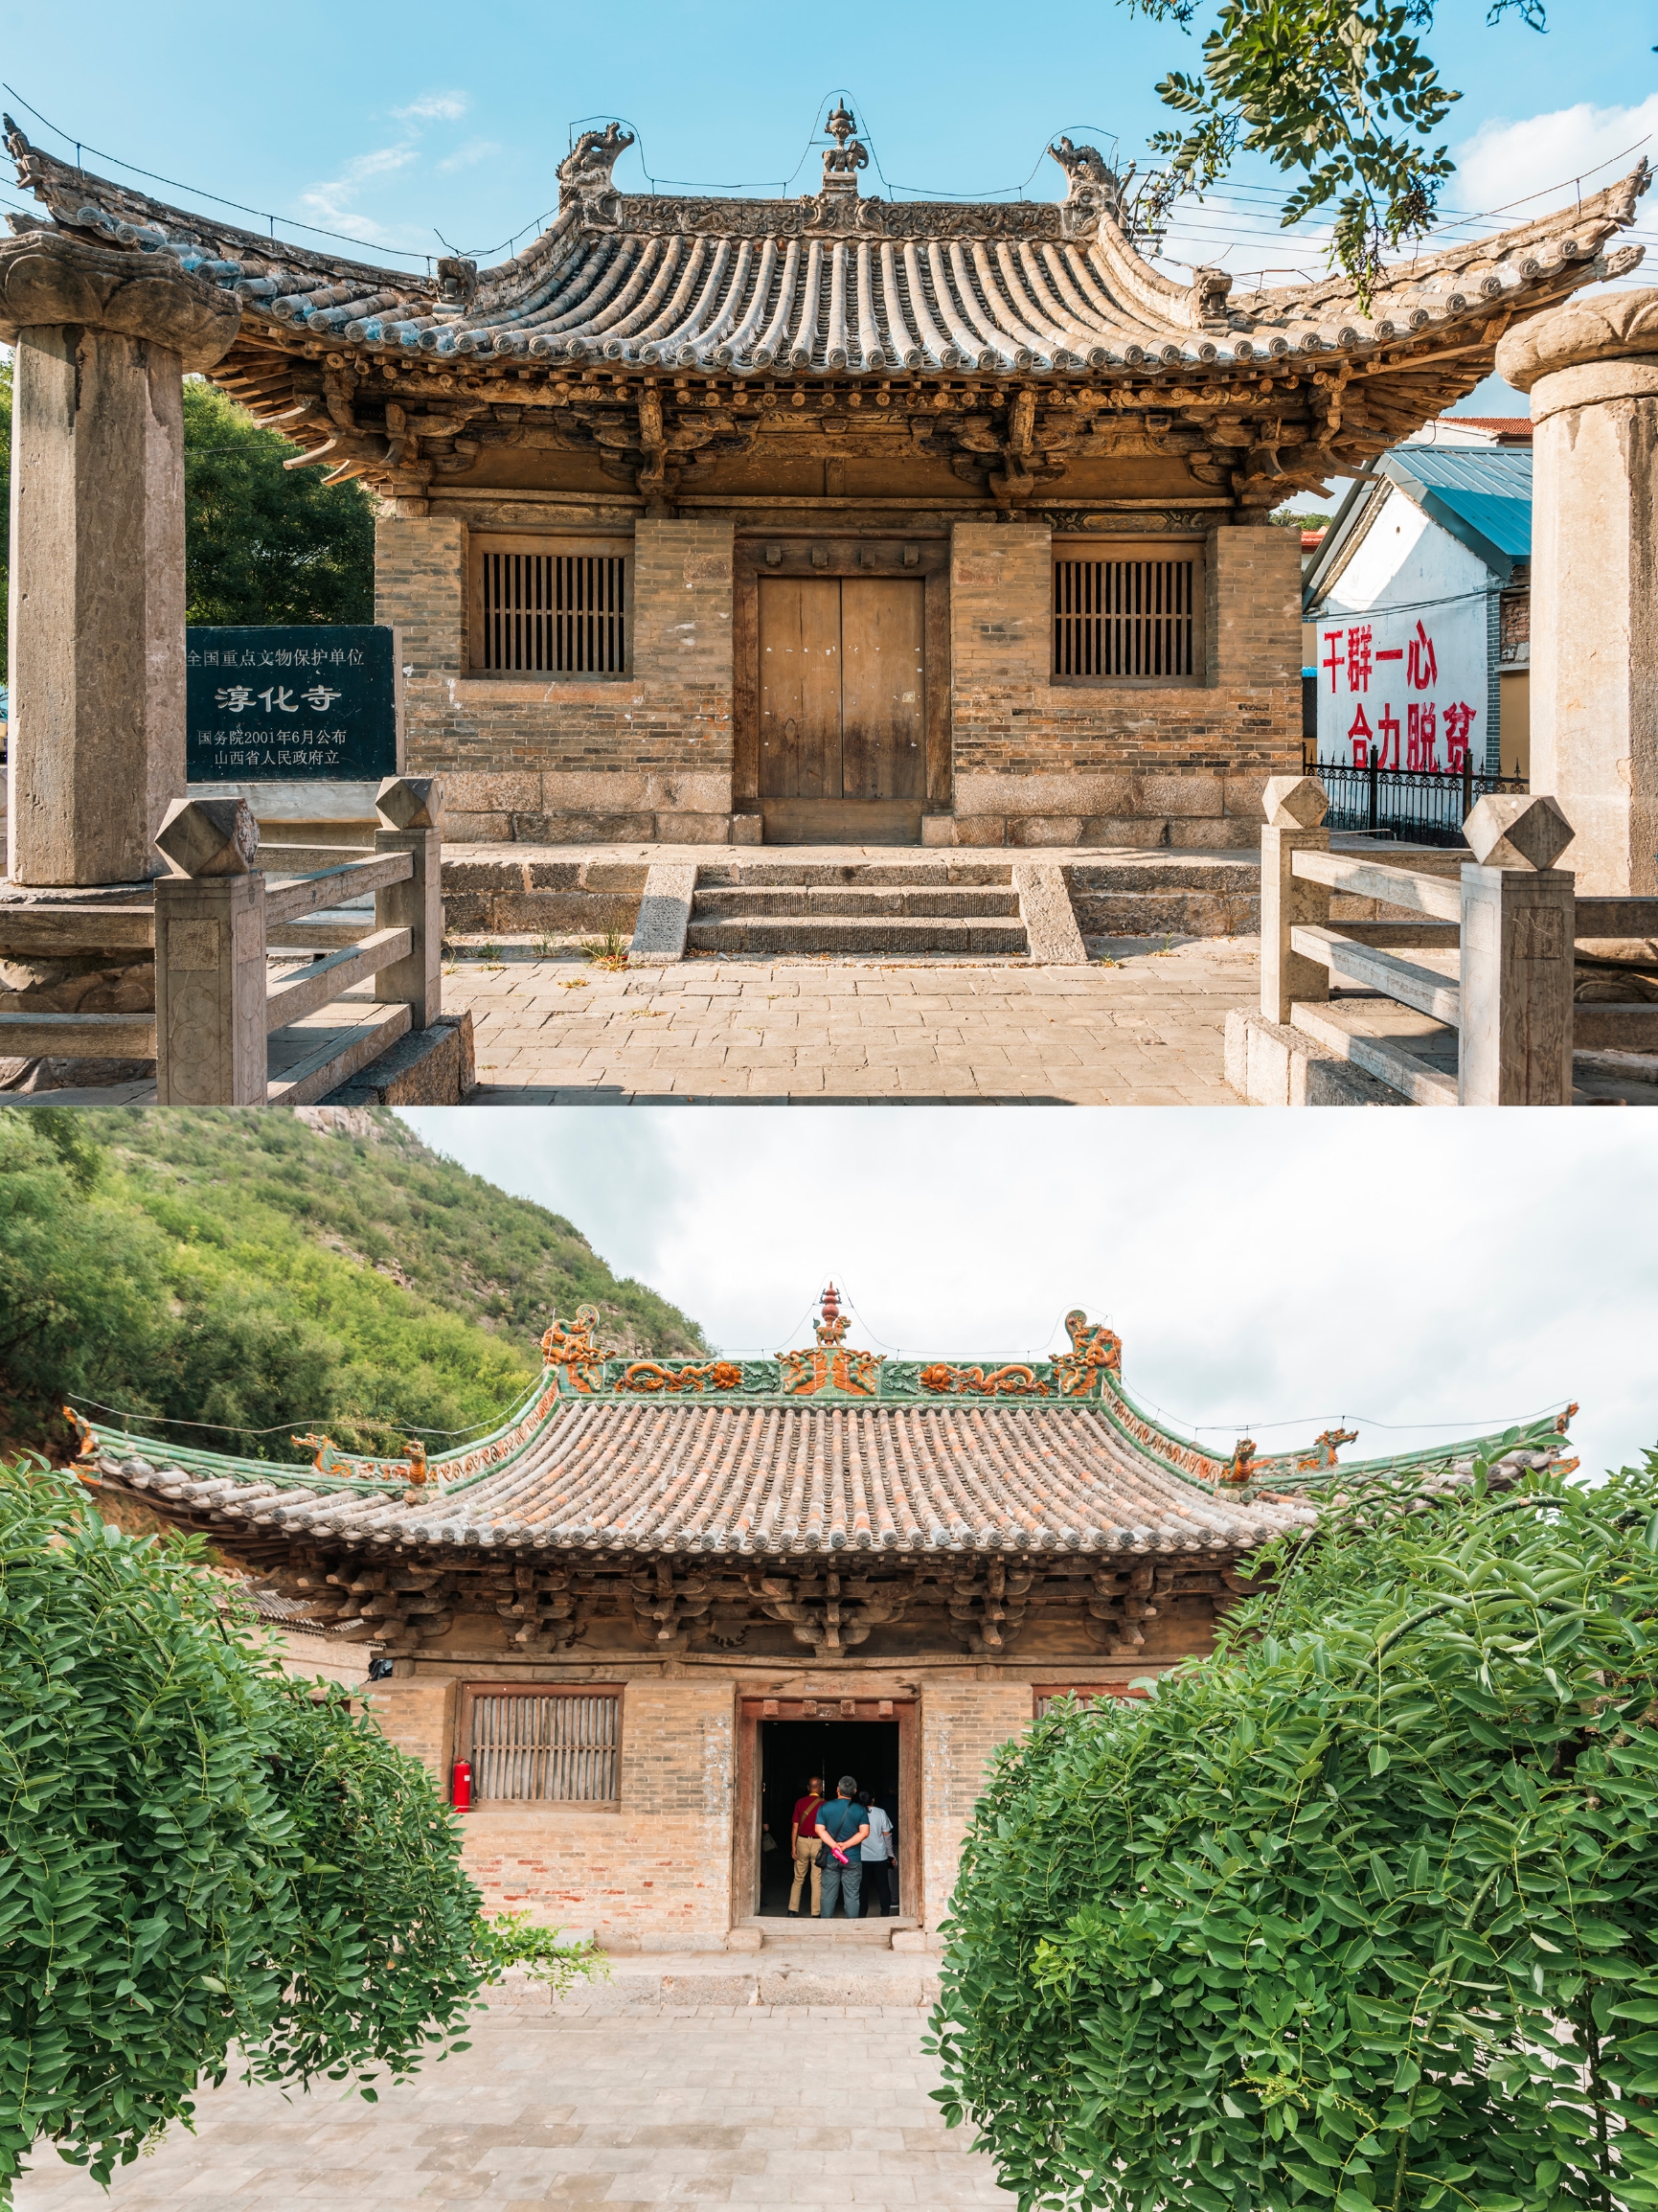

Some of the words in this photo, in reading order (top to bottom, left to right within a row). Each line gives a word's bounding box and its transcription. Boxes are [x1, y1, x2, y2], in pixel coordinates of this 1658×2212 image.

[187, 649, 365, 667] 全国重点文物保护单位
[1323, 619, 1438, 694] 干群一心
[215, 685, 342, 713] 淳化寺
[198, 730, 347, 745] 国务院2001年6月公布
[1348, 700, 1477, 774] 合力脱贫
[215, 750, 339, 765] 山西省人民政府立
